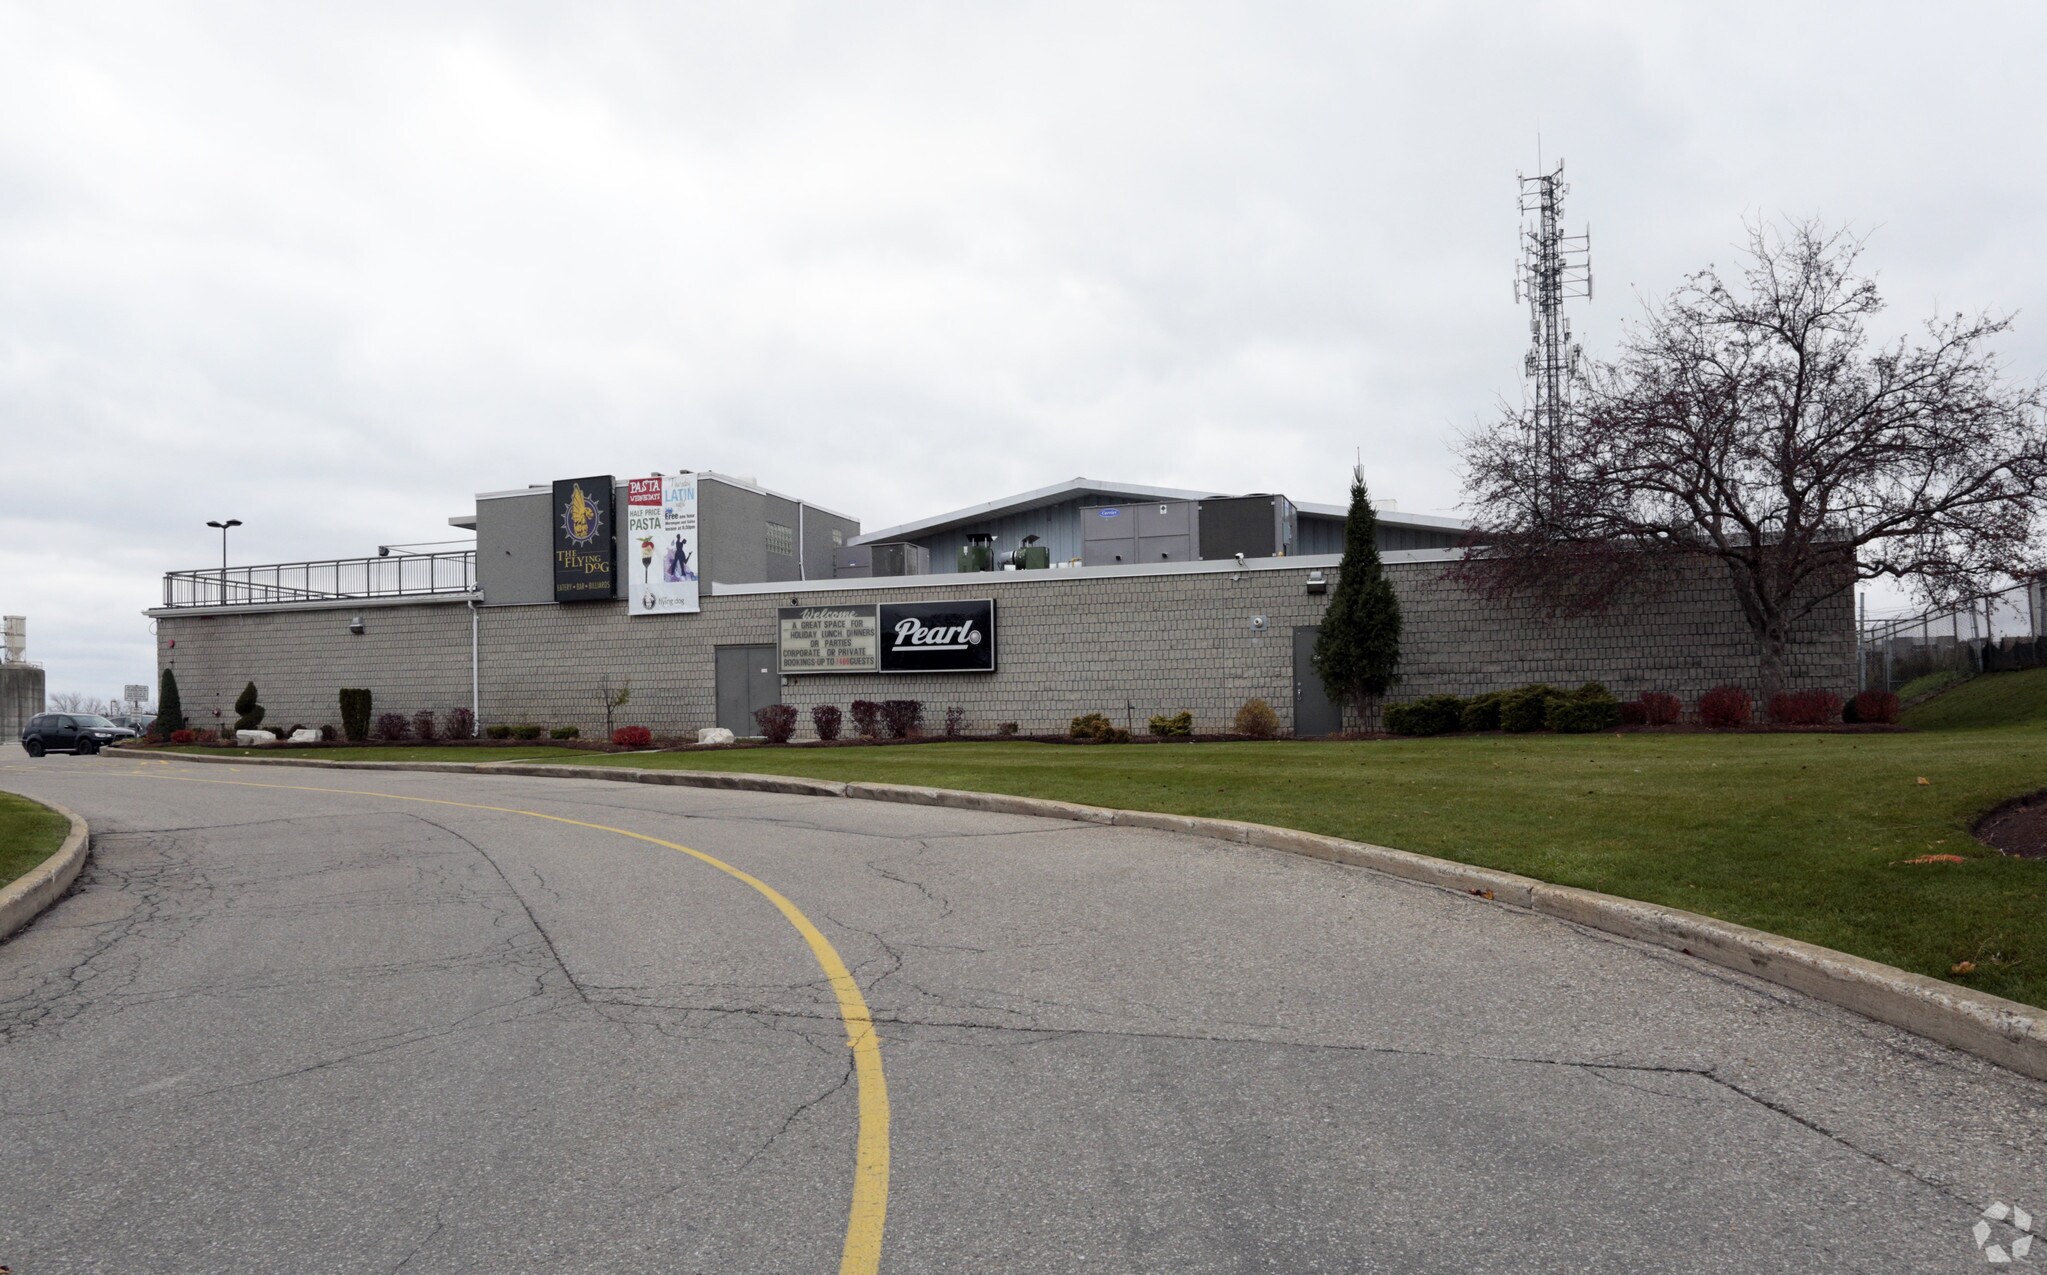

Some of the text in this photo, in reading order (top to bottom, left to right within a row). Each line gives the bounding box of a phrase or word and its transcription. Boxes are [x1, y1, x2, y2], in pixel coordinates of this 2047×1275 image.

[630, 480, 661, 494] PASTA
[665, 488, 695, 502] LATIN
[630, 508, 661, 517] HALF PRICE
[665, 512, 679, 520] Free
[630, 517, 661, 531] PASTA
[556, 549, 577, 561] THE
[565, 554, 601, 568] FLYING
[585, 561, 610, 574] DOG
[576, 582, 585, 590] BAR
[800, 608, 858, 620] Welcome
[792, 620, 864, 630] A GREAT SPACE FOR
[790, 628, 875, 639] HOLIDAY LUNCH DINNERS
[894, 617, 974, 645] Pearl
[810, 639, 852, 648] OR PARTIES
[783, 648, 867, 657] CORPORATE OR PRIVATE
[783, 658, 815, 667] BOOKINGS
[816, 658, 826, 666] UP
[826, 658, 835, 666] TO
[849, 656, 875, 665] GUESTS
